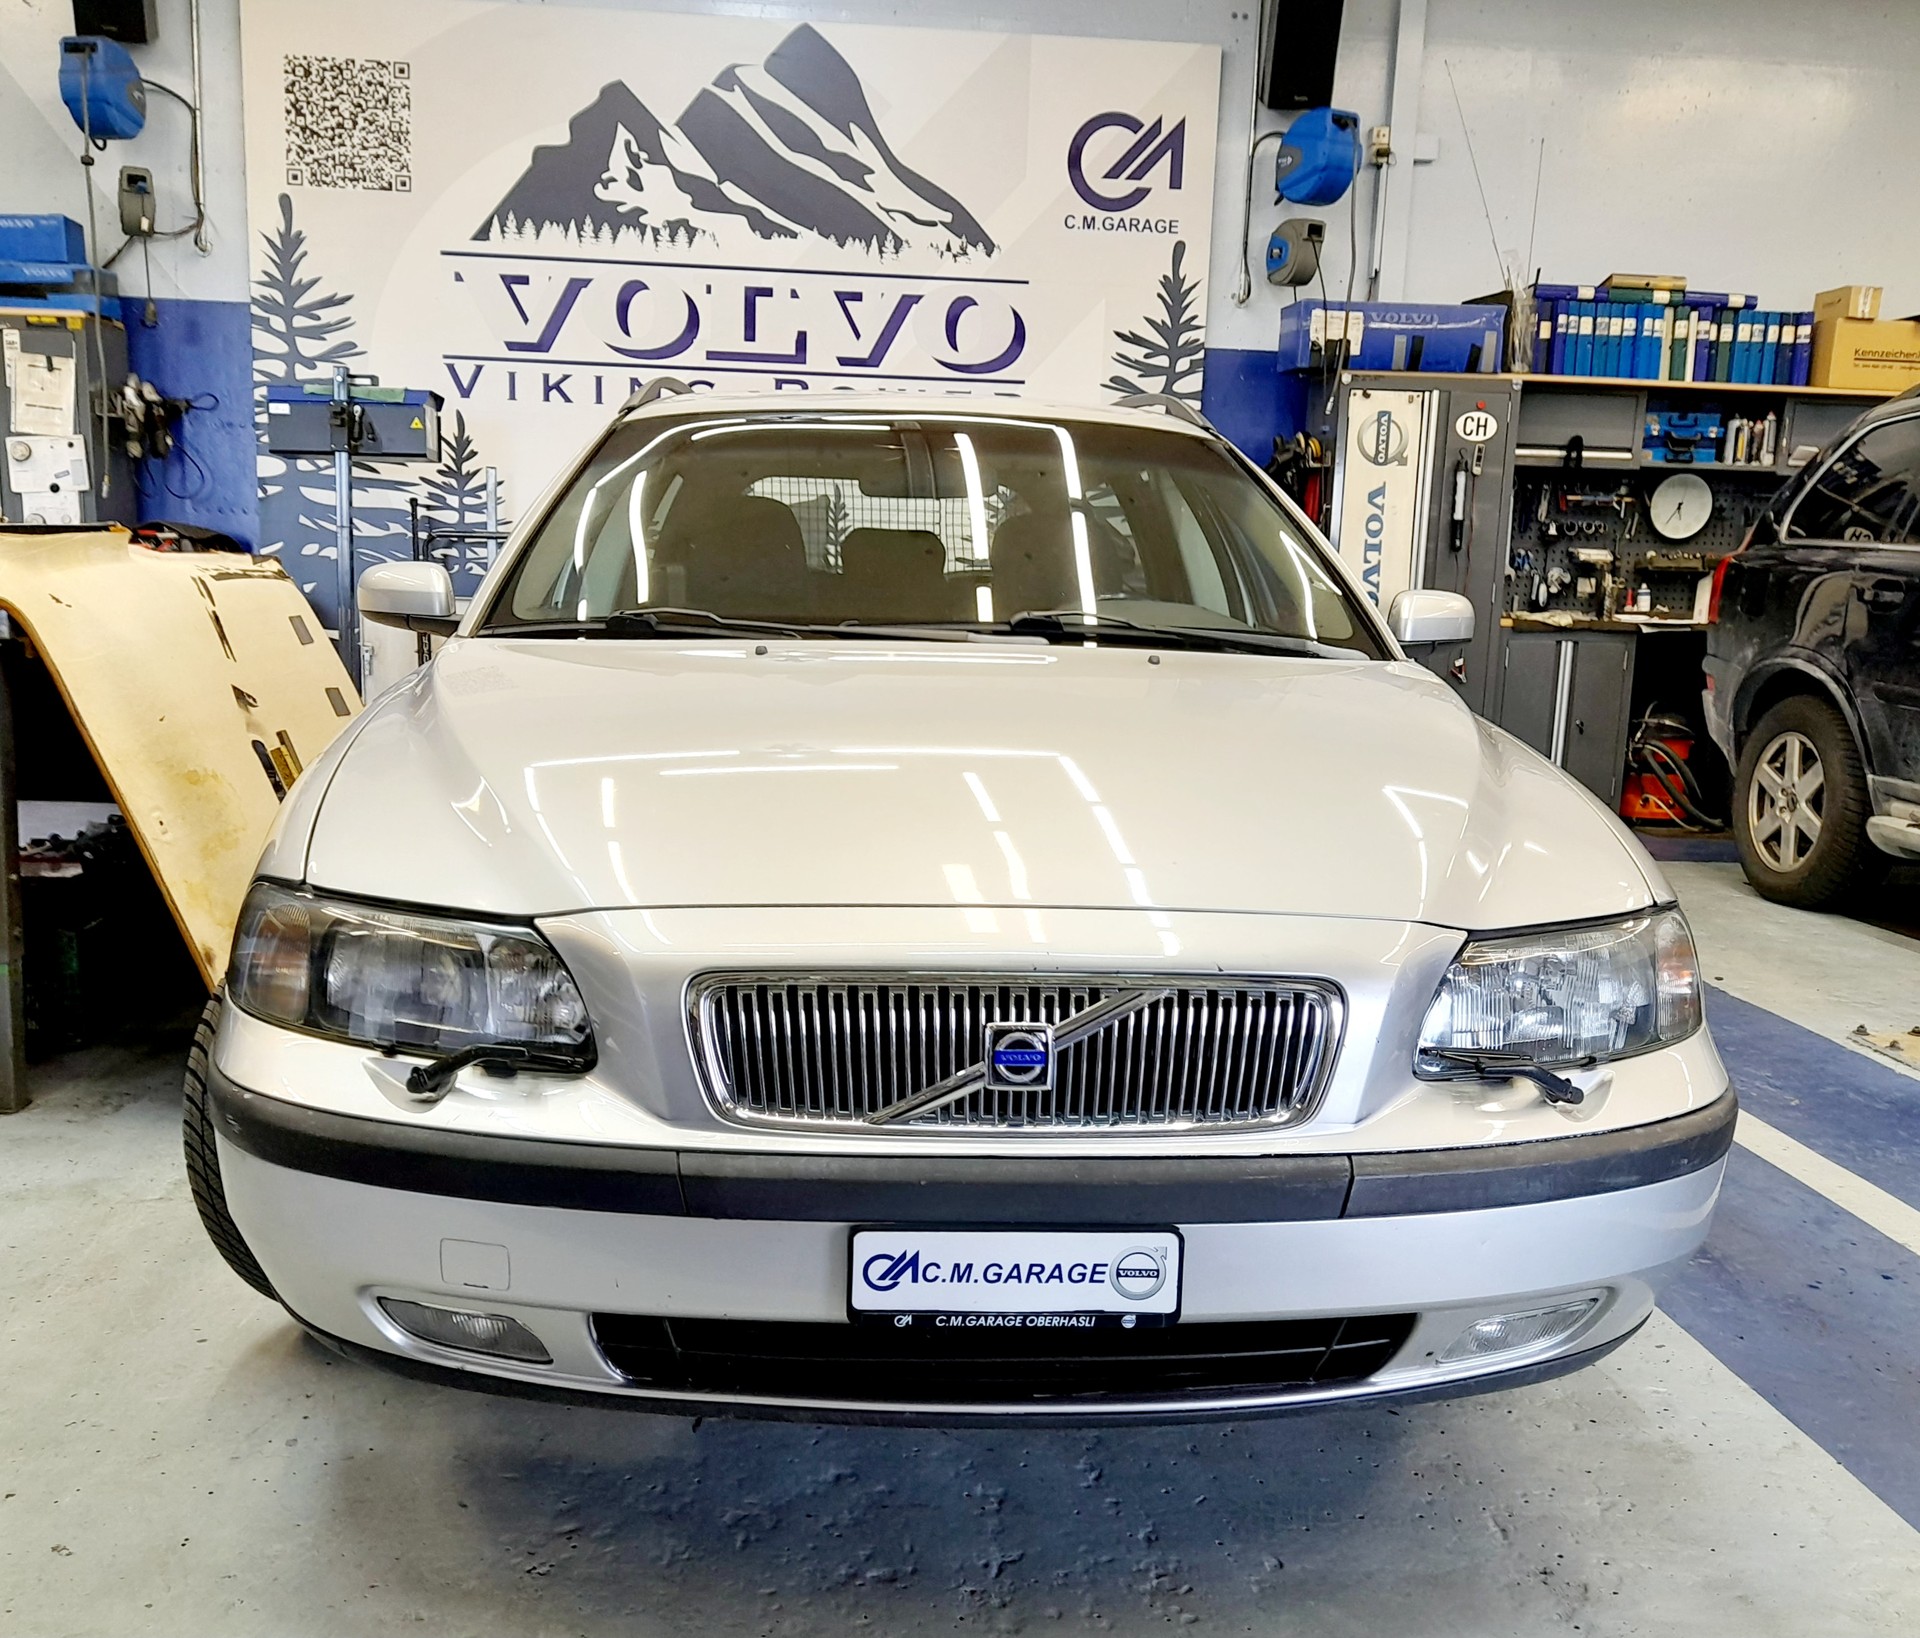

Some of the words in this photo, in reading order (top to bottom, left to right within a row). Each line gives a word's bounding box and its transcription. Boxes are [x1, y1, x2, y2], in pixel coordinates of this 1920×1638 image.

[1064, 214, 1180, 234] C.M.GARAGE
[450, 267, 1027, 375] VOLVO
[1369, 311, 1439, 325] VOLVO
[1462, 415, 1488, 437] CH
[1375, 412, 1390, 464] VOLVO
[1000, 1054, 1042, 1062] VOLVO
[921, 1262, 1109, 1284] C.M.GARAGE
[1118, 1269, 1158, 1277] VOLVO
[936, 1315, 1023, 1327] C.M.GARAGE
[1026, 1316, 1096, 1327] OBERHASLI
